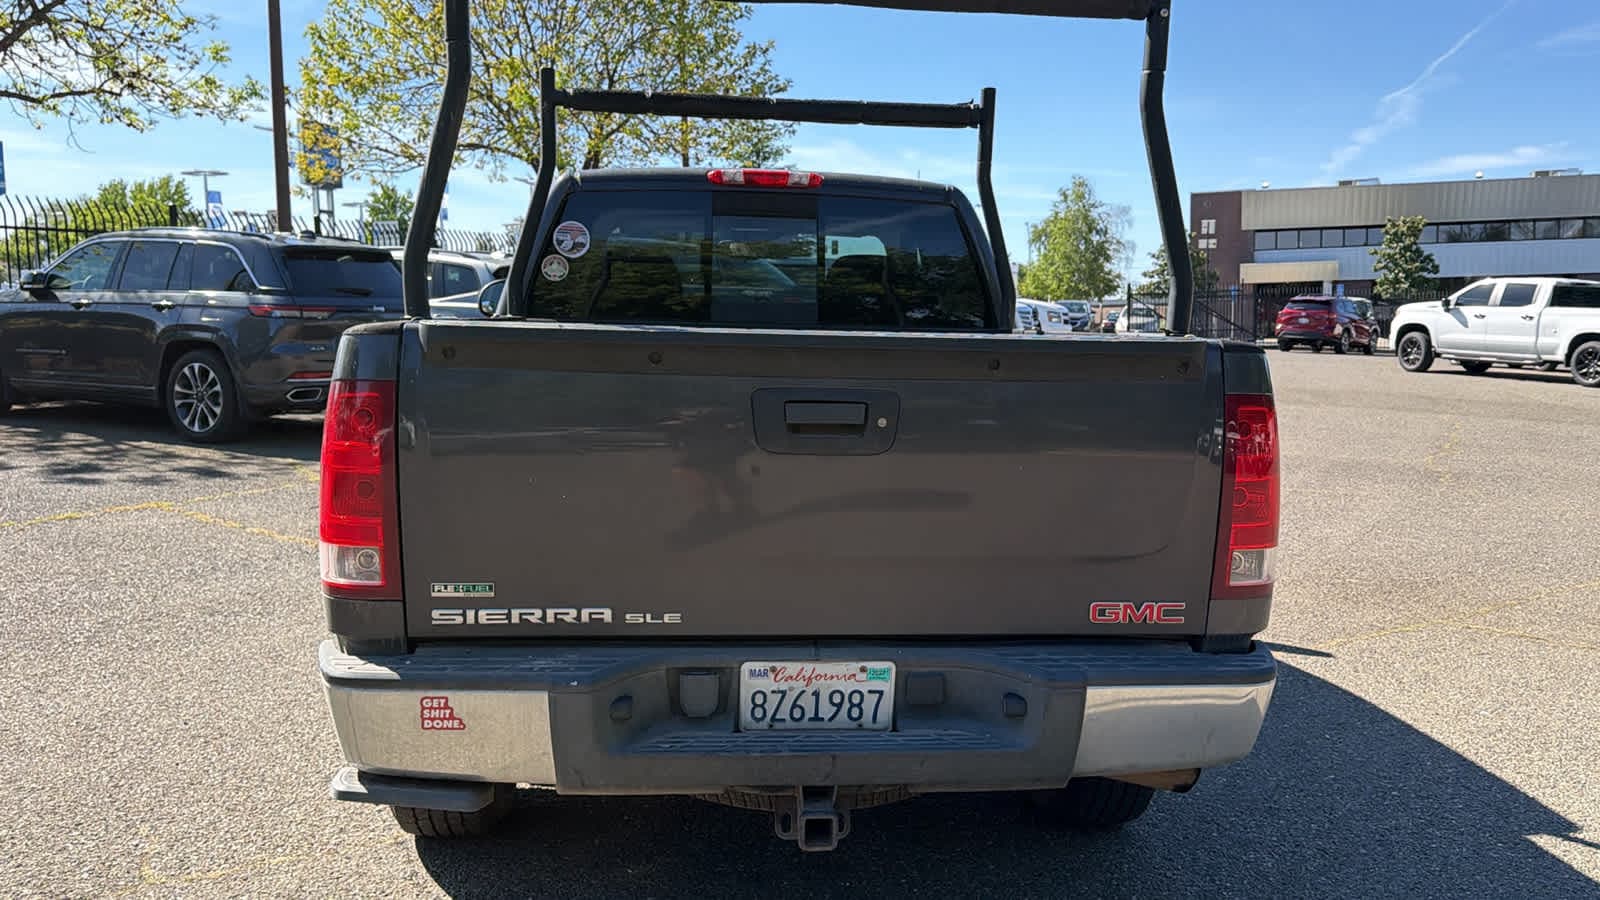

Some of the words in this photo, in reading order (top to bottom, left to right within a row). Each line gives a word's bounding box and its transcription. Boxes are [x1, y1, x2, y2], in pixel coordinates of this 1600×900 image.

[431, 607, 613, 625] SIERRA
[624, 613, 682, 624] SLE
[1089, 601, 1186, 624] GMC
[749, 668, 769, 678] MAR
[773, 665, 868, 688] California
[422, 698, 446, 708] GET
[750, 689, 885, 724] 8Z61987
[423, 709, 451, 718] SHIT
[423, 719, 464, 729] DONE.
